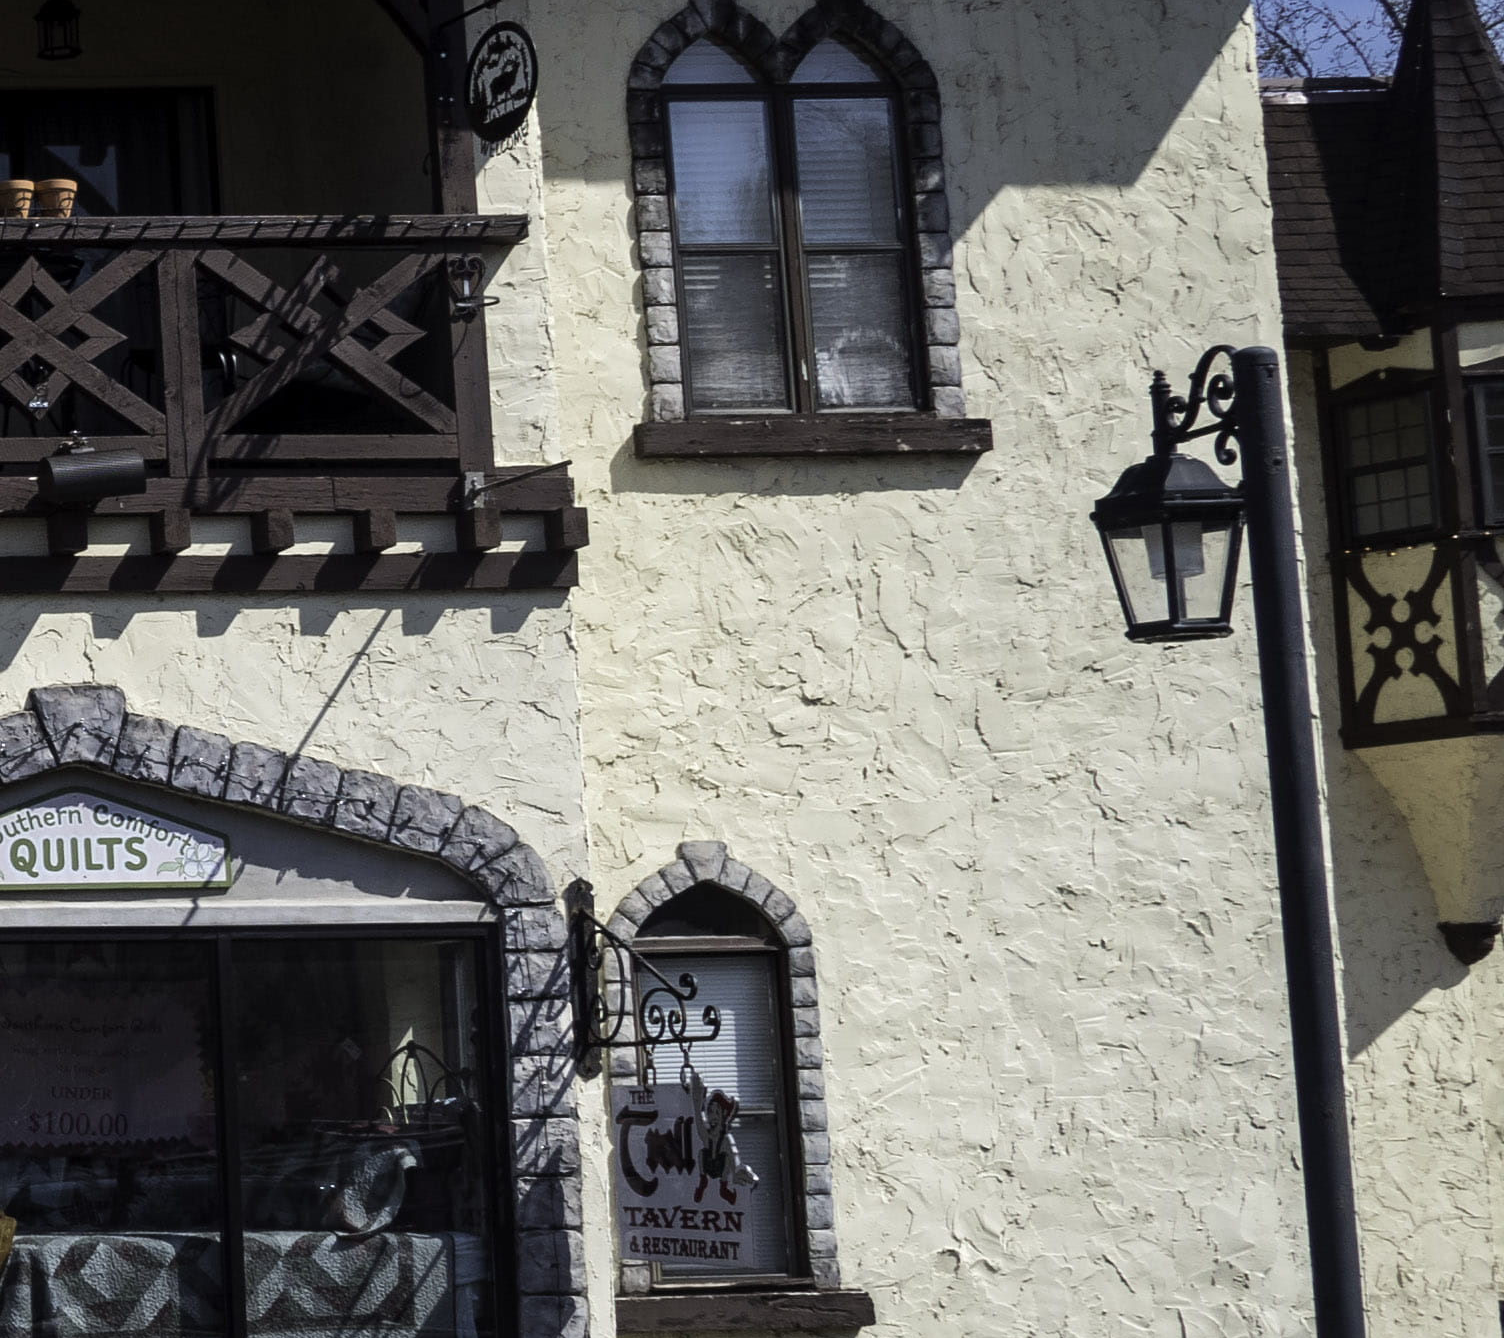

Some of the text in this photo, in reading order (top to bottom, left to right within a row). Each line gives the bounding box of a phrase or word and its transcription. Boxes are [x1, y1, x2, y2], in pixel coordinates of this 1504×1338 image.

[479, 118, 529, 158] WELCOME
[93, 804, 193, 855] Comfort
[10, 837, 148, 878] QUILTS
[50, 1085, 113, 1101] UNDER
[629, 1090, 656, 1105] THE
[28, 1109, 129, 1137] $100.00
[623, 1206, 745, 1233] TAVERN
[630, 1235, 740, 1261] & RESTAURANT
